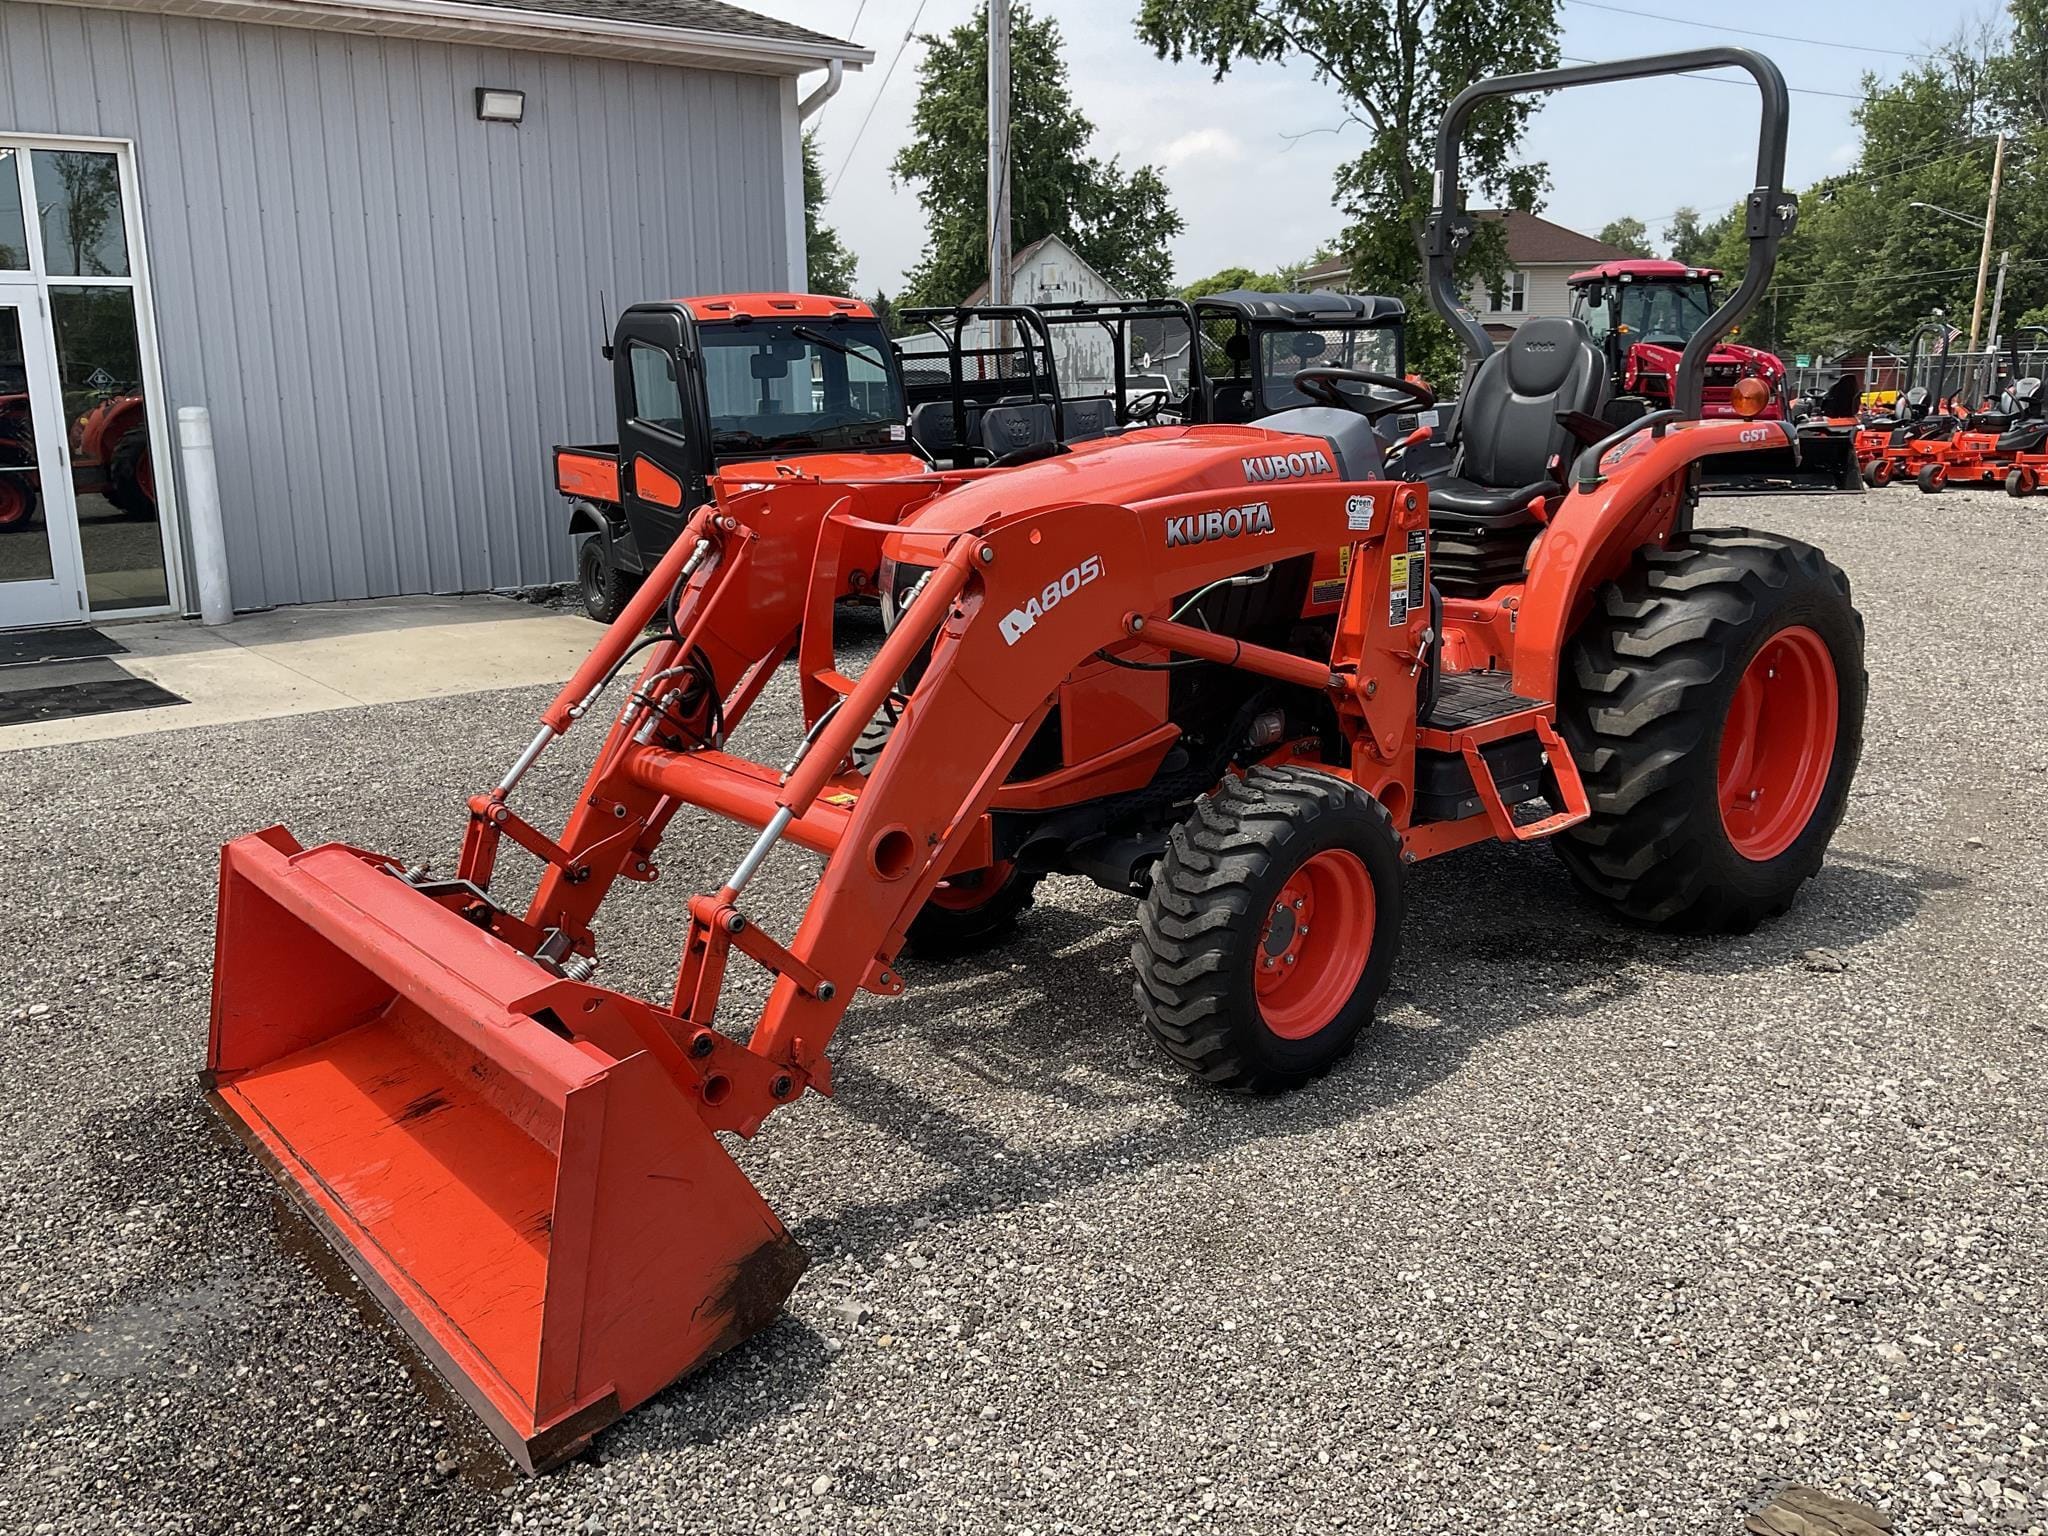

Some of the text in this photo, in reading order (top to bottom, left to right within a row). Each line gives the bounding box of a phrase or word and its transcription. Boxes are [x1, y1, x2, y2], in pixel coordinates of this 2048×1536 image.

[1740, 429, 1768, 443] GST
[1241, 451, 1333, 482] KUBOTA
[1166, 502, 1274, 548] KUBOTA
